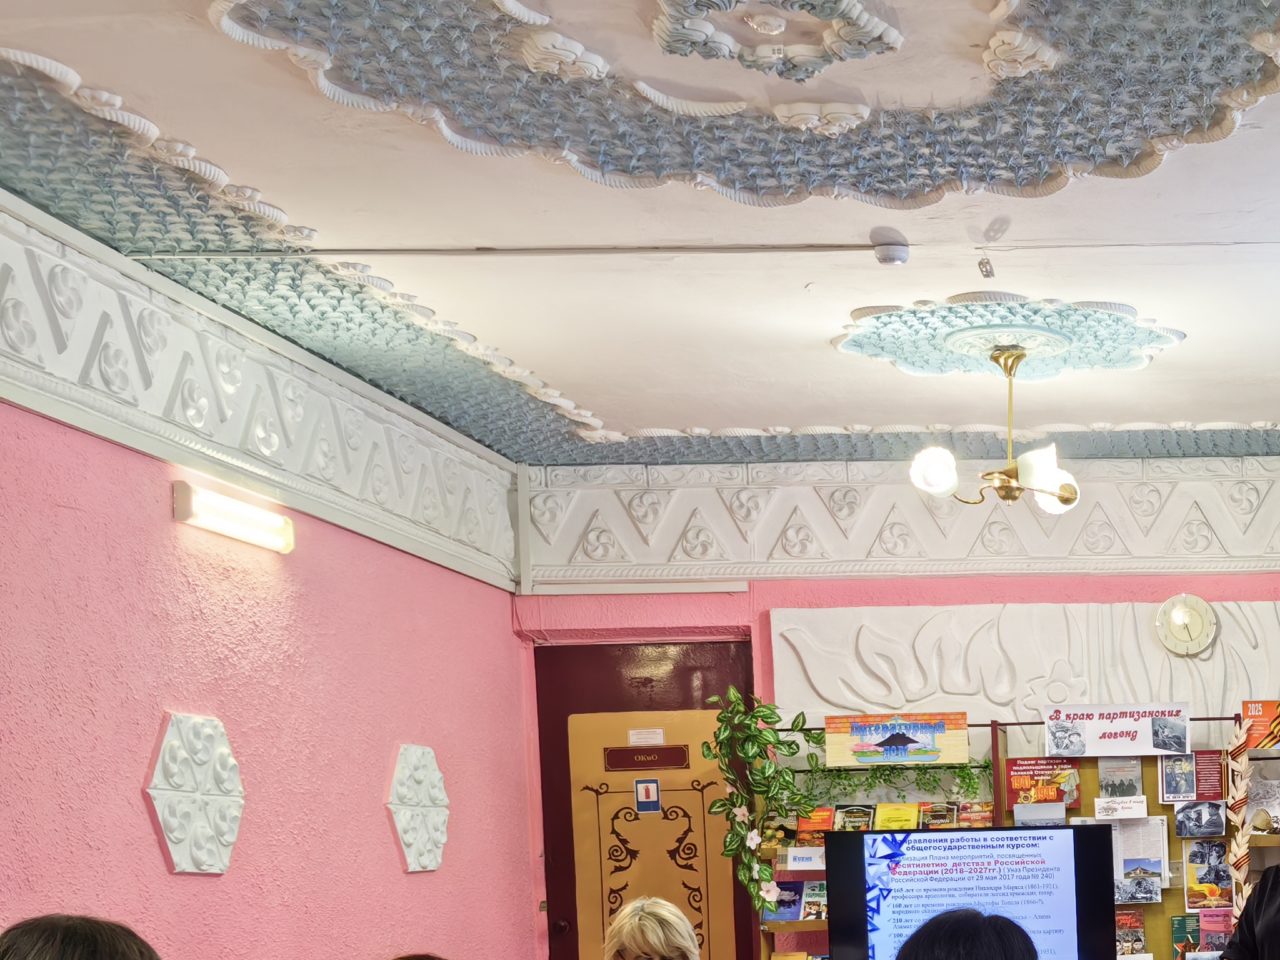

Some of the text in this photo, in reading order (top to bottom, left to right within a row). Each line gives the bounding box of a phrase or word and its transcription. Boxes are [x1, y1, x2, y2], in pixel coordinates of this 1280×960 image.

[1248, 704, 1263, 716] 2025
[1048, 709, 1182, 723] В краю партизанских
[1099, 730, 1138, 741] легенд
[949, 836, 981, 844] работы
[905, 842, 1040, 852] общегосударственным курсом:
[994, 858, 1046, 867] Российской
[890, 868, 939, 877] Федерации
[999, 873, 1015, 881] 2017
